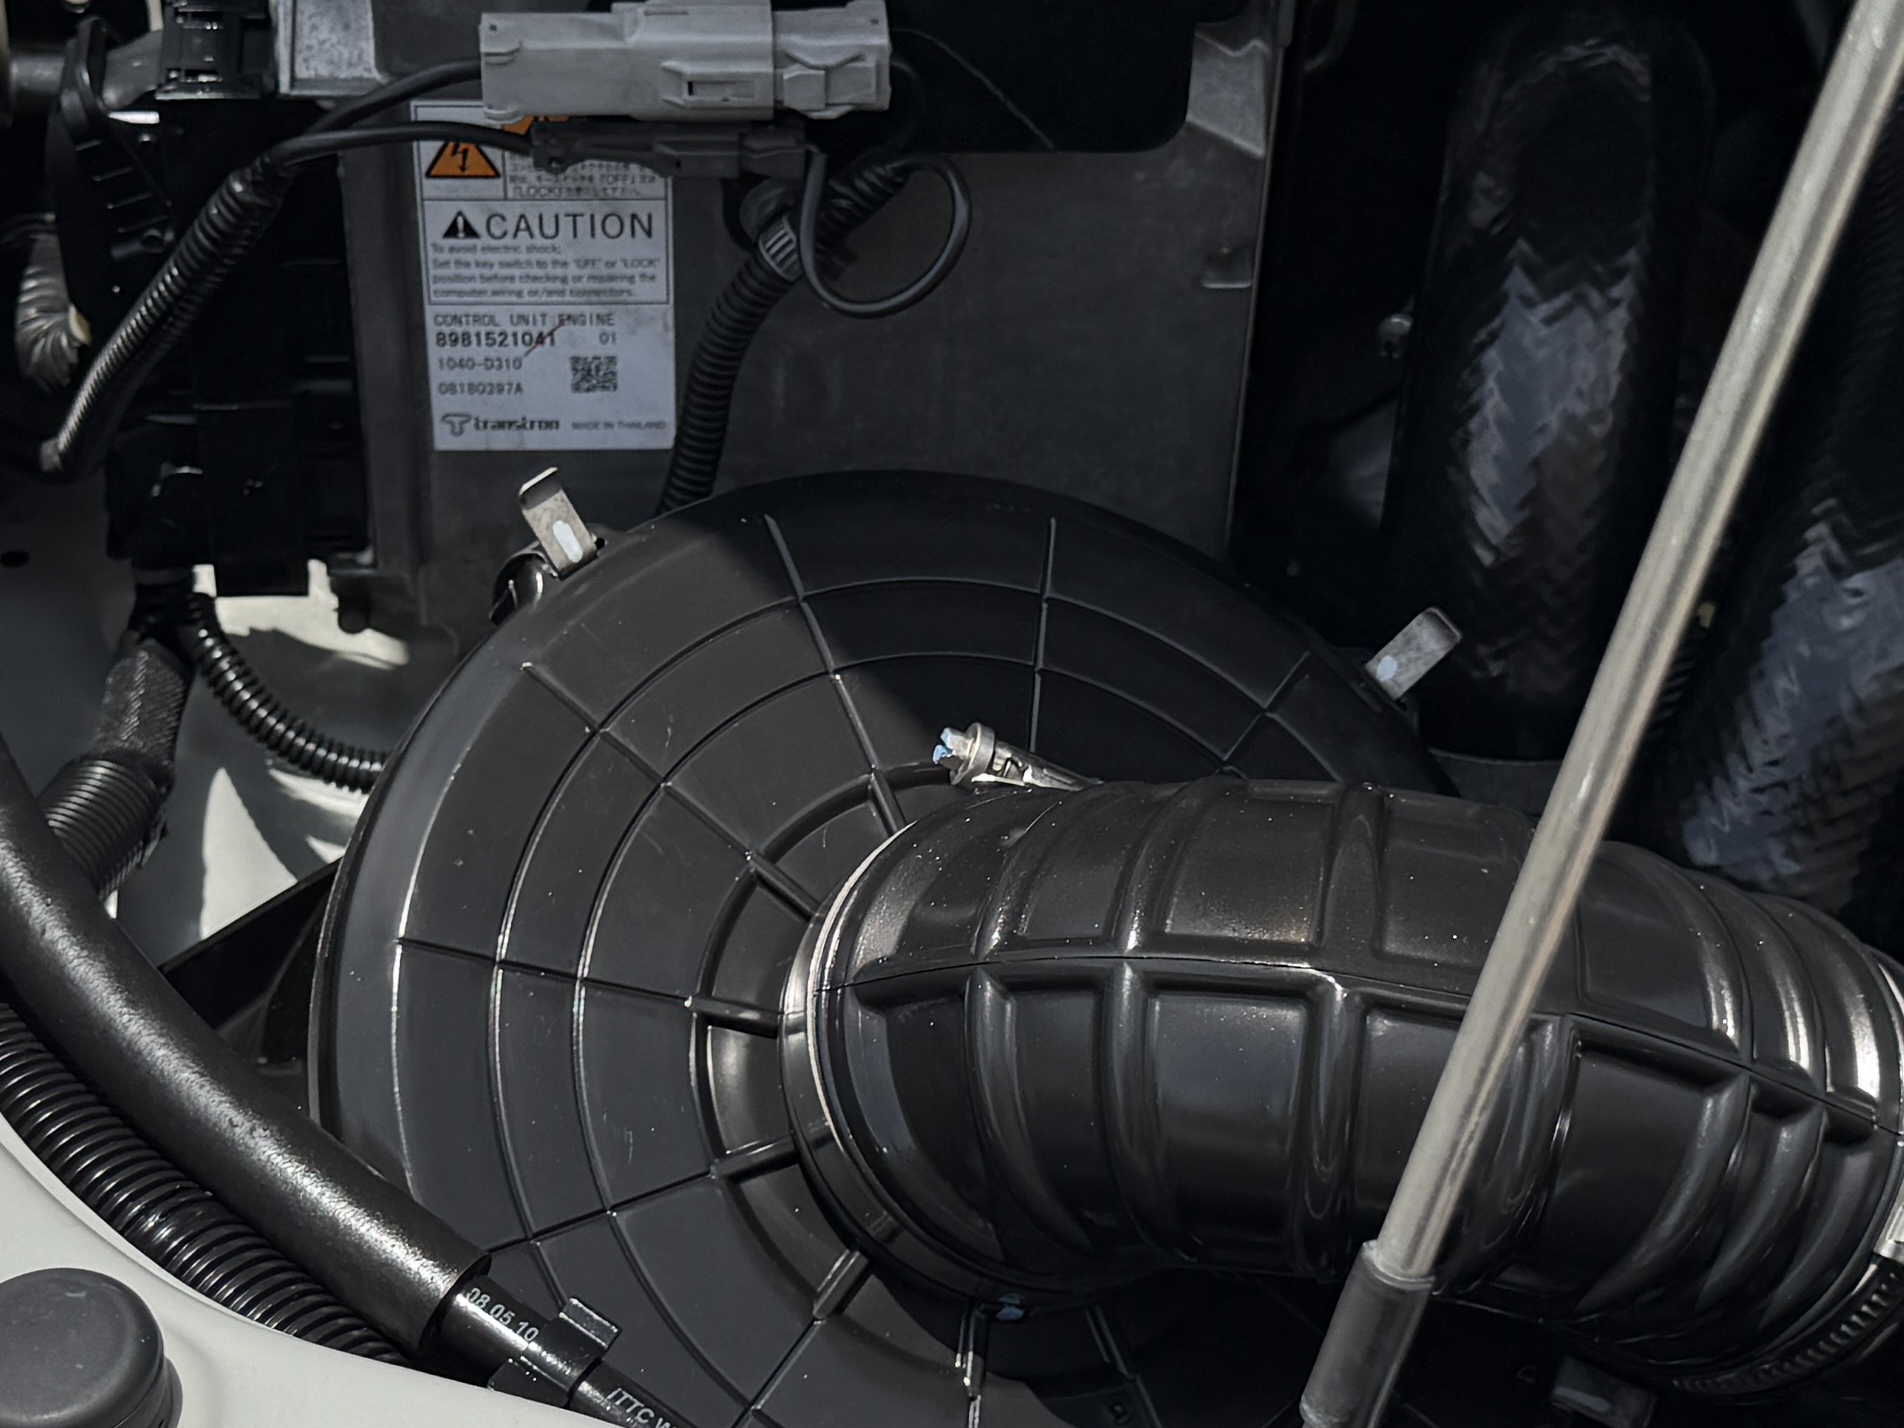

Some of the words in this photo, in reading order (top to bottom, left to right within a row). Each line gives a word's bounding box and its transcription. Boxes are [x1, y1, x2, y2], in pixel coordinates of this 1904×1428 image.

[485, 212, 653, 240] CAUTION
[481, 243, 521, 254] electric
[454, 258, 472, 269] the
[475, 259, 494, 272] key
[498, 258, 533, 270] switch
[551, 258, 569, 270] the
[479, 273, 515, 283] before
[519, 272, 569, 285] checking
[638, 272, 655, 283] the
[434, 313, 500, 327] CONTROL
[510, 313, 548, 326] UNIT
[558, 313, 615, 326] ENGINE
[436, 331, 556, 347] 8981521041
[599, 332, 617, 345] 01
[466, 1287, 491, 1309] 08
[490, 1305, 515, 1327] 05
[516, 1321, 540, 1343] 10
[606, 1387, 655, 1425] ITTC
